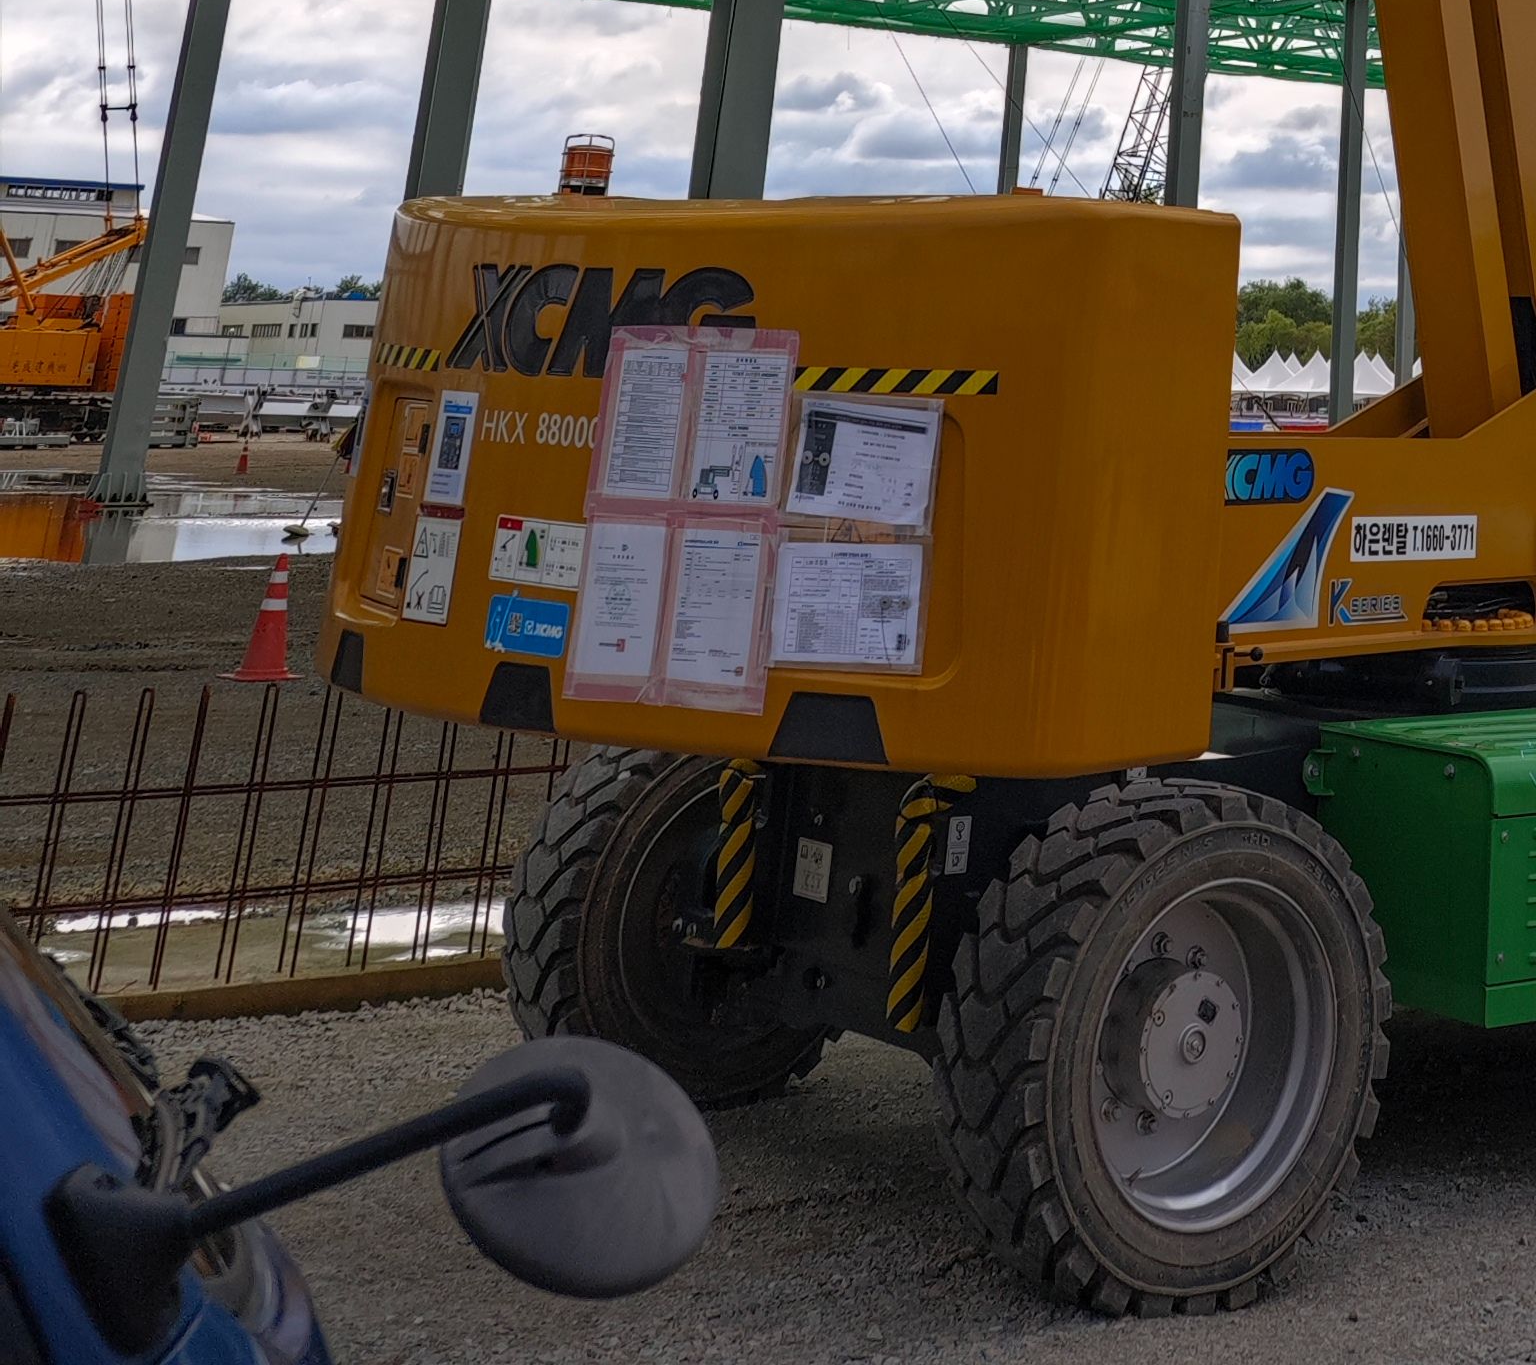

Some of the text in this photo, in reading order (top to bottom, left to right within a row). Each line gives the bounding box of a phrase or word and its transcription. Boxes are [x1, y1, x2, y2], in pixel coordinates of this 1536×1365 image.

[481, 409, 528, 445] HKX
[1353, 522, 1475, 557] 하은렌탈 T.1660-3771
[1351, 595, 1401, 614] SERIES
[534, 622, 563, 639] XCMG
